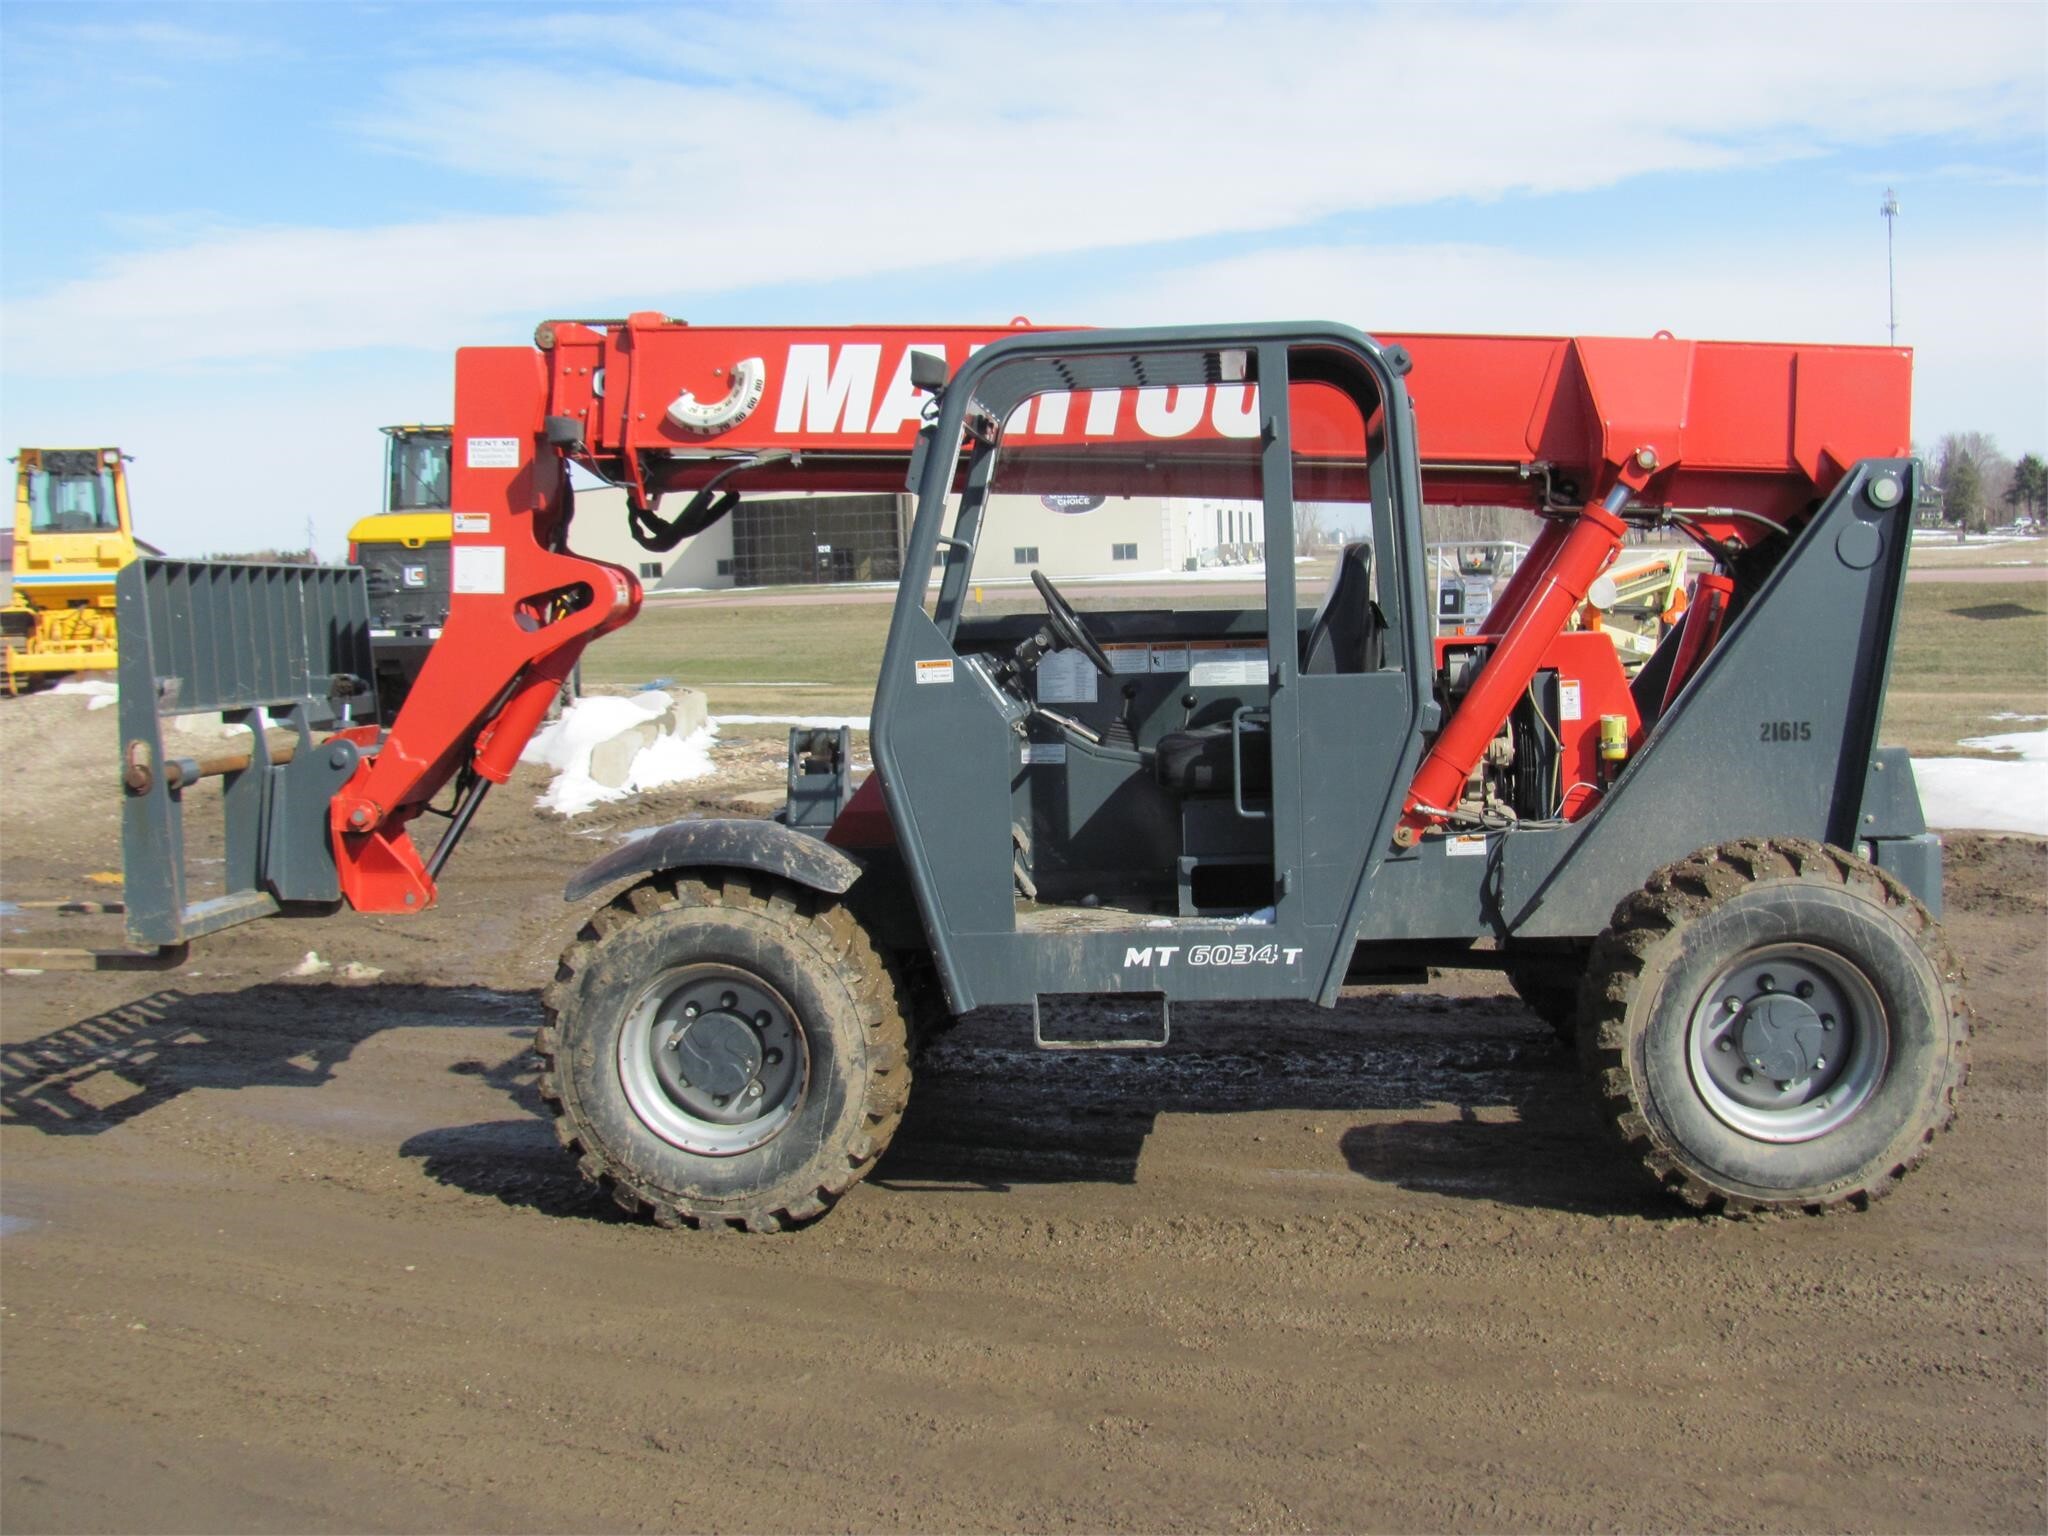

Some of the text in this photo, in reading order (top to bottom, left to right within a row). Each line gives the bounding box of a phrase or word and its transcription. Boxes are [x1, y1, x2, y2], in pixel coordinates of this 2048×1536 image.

[1057, 498, 1090, 506] CHOICE
[1760, 721, 1811, 742] 21615
[1124, 946, 1180, 967] MT
